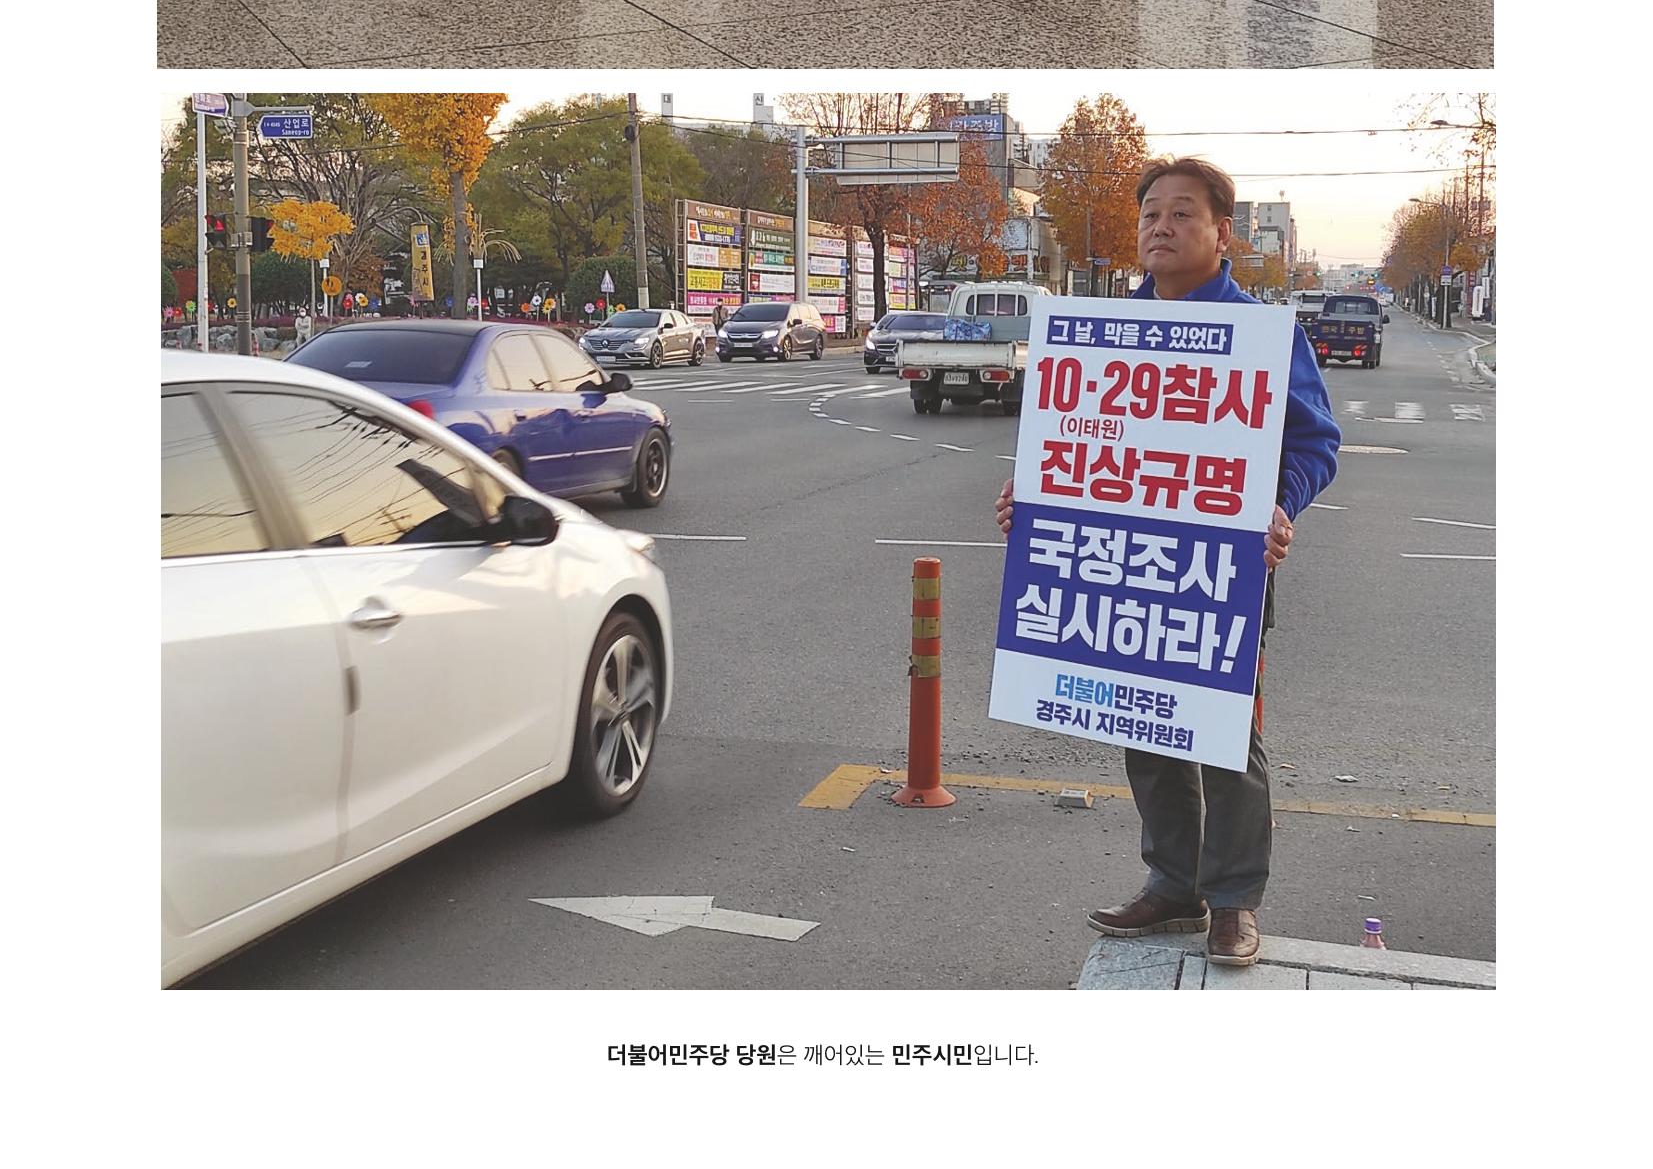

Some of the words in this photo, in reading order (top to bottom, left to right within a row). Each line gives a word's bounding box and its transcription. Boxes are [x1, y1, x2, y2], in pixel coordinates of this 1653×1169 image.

[283, 118, 310, 130] 산업로
[1051, 320, 1068, 342] 그
[1074, 321, 1096, 345] 날,
[1104, 324, 1140, 347] 막을
[1145, 326, 1163, 348] 수
[1168, 326, 1228, 352] 있었다
[1037, 357, 1273, 429] 10·29참사
[1059, 415, 1125, 441] (이태원)
[1040, 439, 1247, 516] 진상규명
[1029, 518, 1238, 603] 국정조사
[1015, 583, 1247, 674] 실시하라!
[1055, 673, 1178, 720] 더불어민주당
[1036, 699, 1091, 731] 경주시
[1096, 711, 1194, 752] 지역위원회
